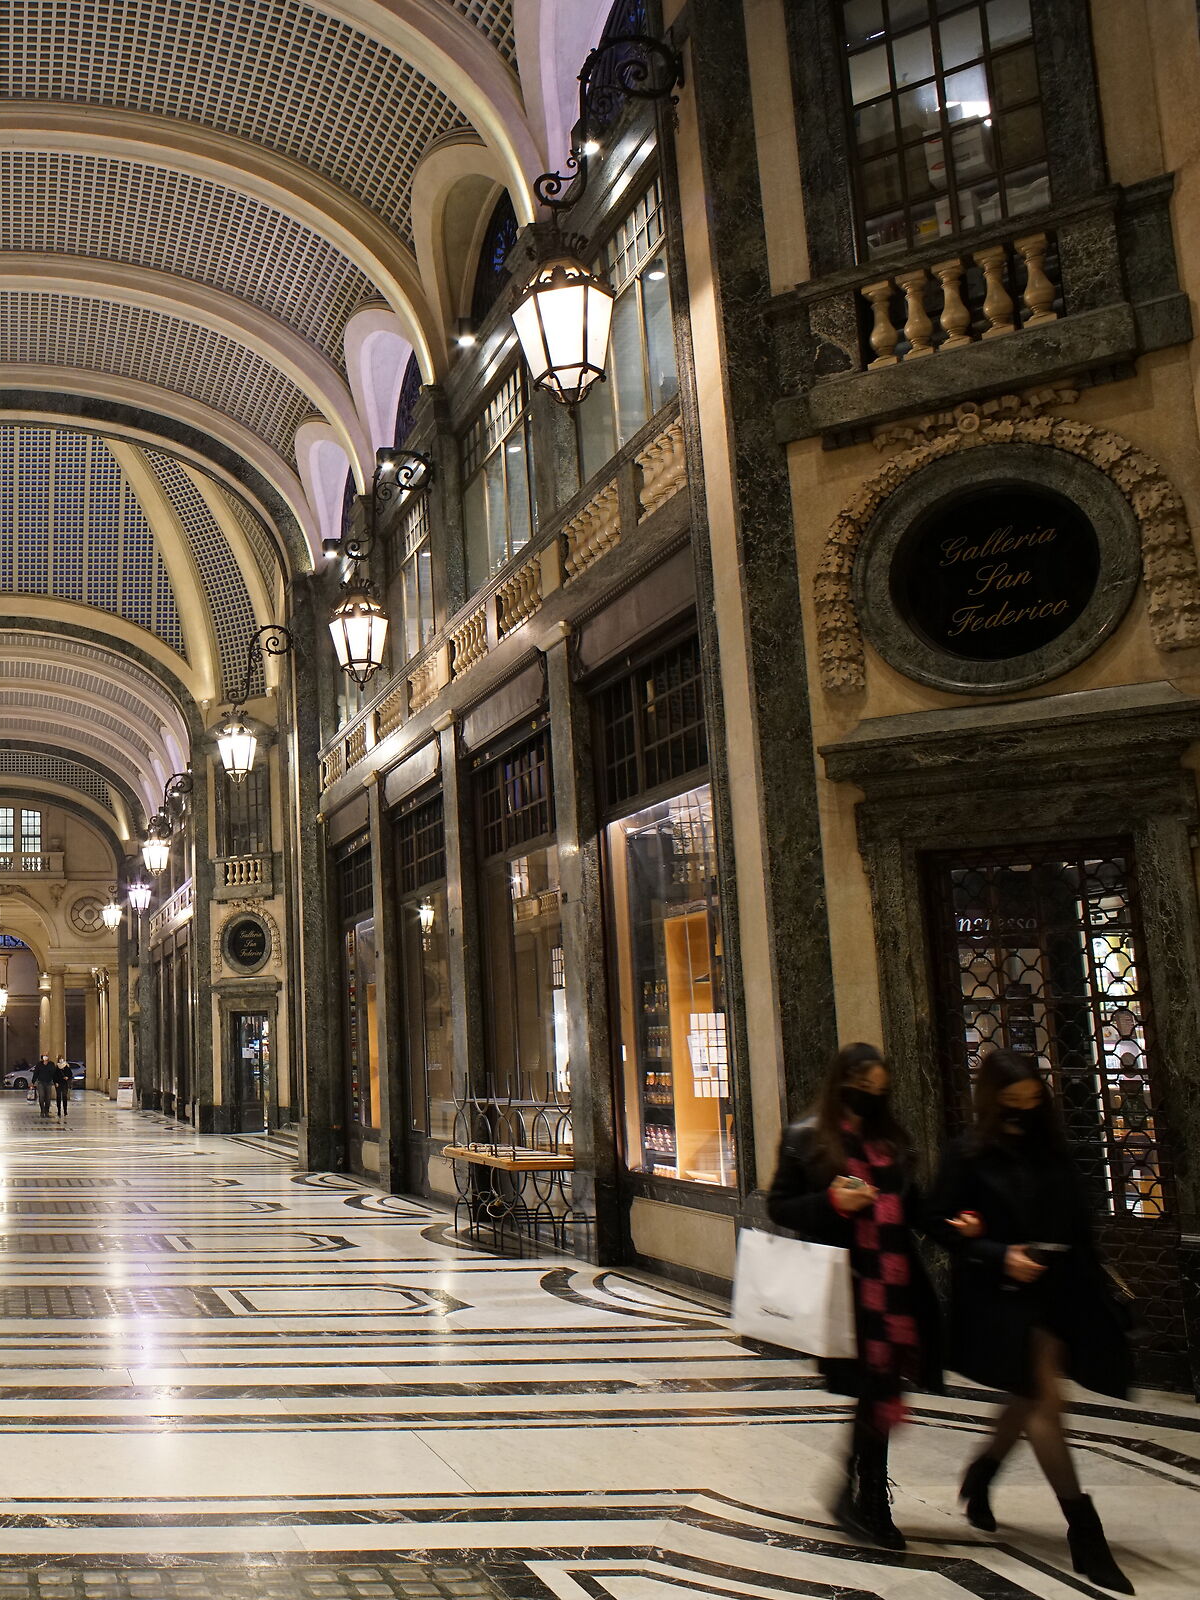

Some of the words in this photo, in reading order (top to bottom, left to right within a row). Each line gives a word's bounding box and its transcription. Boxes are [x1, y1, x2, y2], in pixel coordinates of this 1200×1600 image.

[939, 525, 1057, 566] Galleria
[968, 562, 1032, 595] San
[947, 600, 1069, 636] Federico
